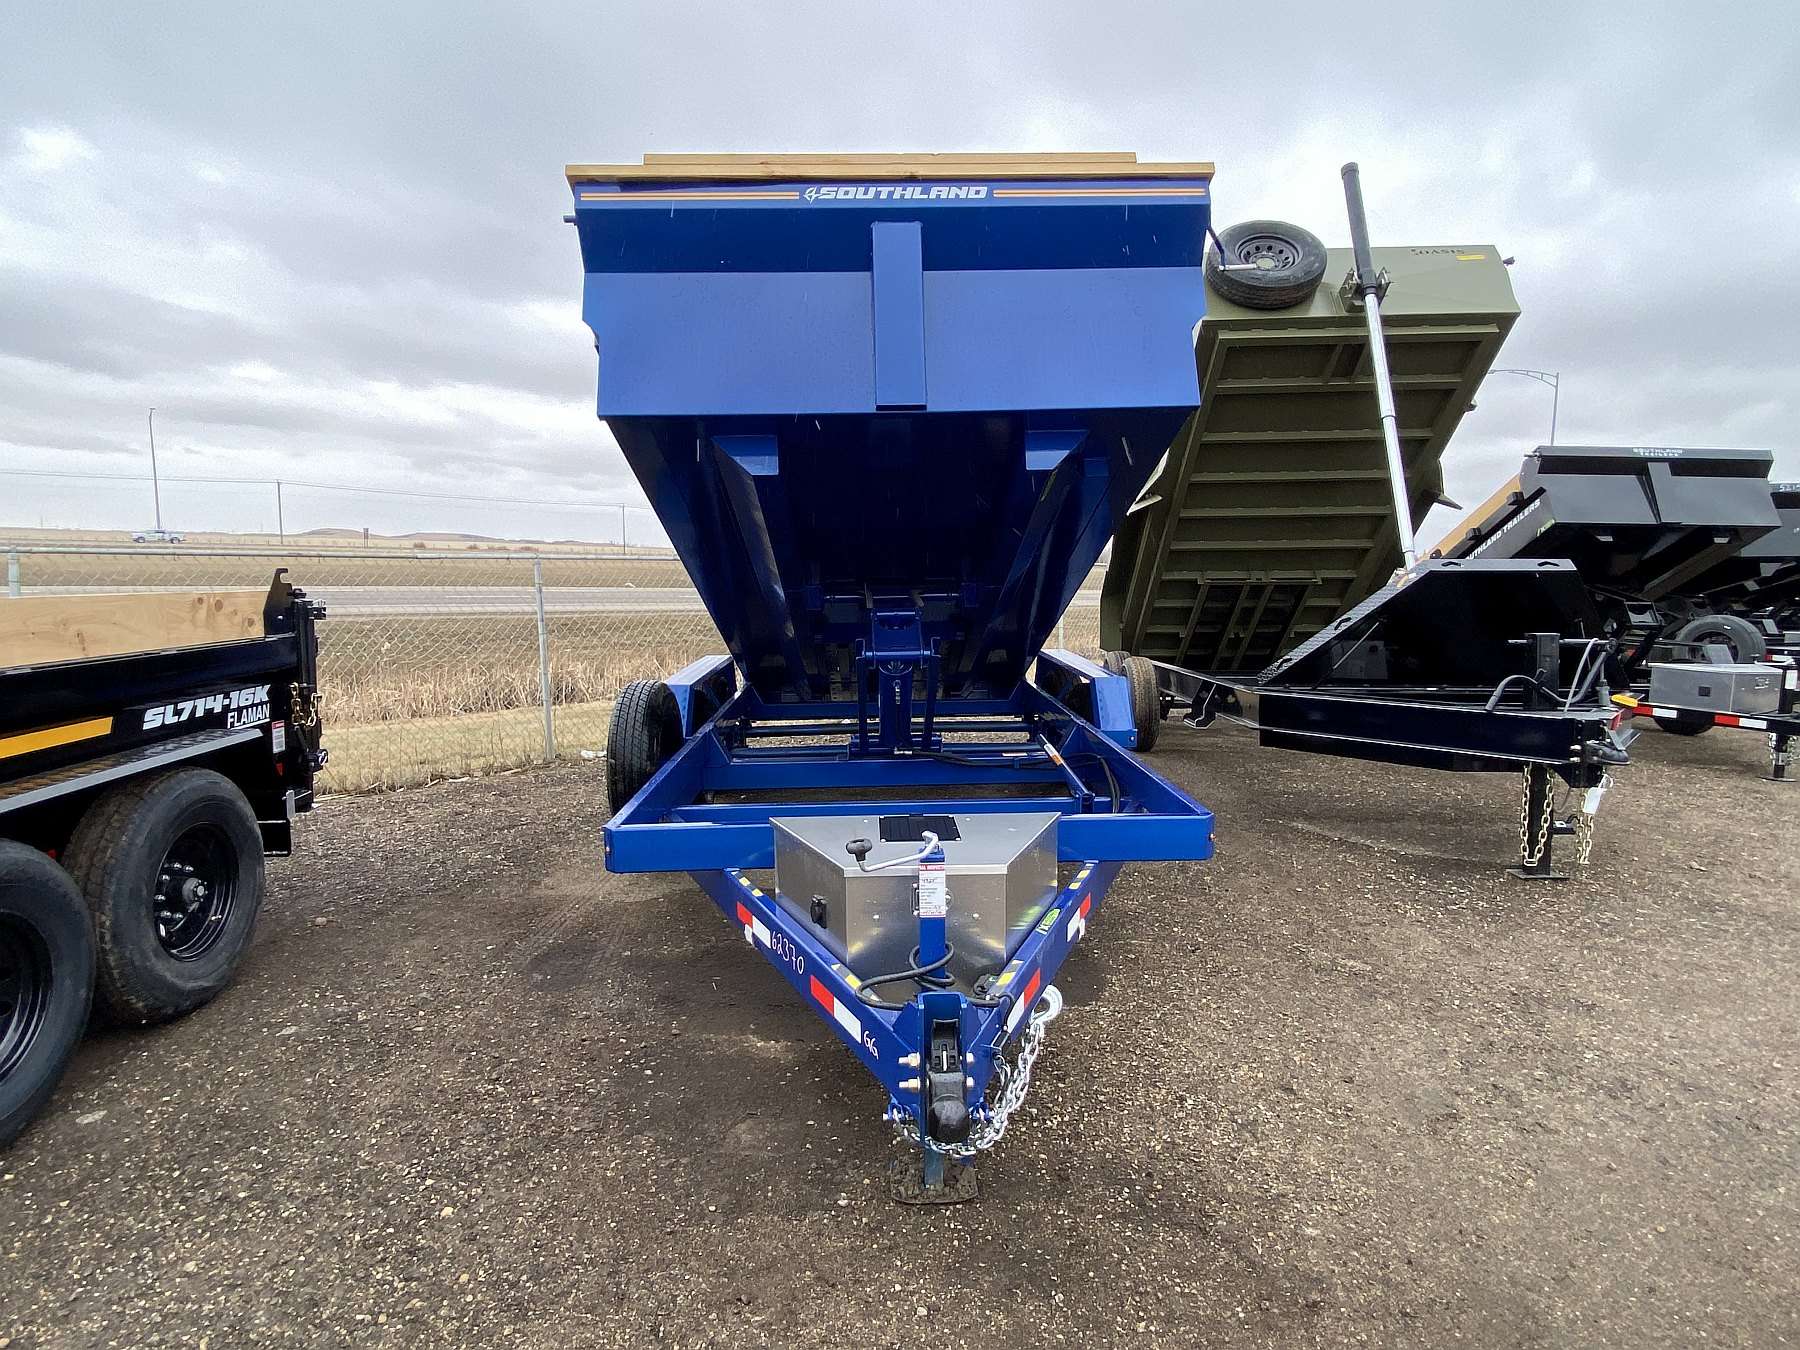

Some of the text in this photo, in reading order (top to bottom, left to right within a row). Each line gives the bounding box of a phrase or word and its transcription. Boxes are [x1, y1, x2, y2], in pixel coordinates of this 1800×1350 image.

[817, 186, 988, 200] SOUTHLAND
[1503, 498, 1541, 533] TRAILERS
[142, 684, 271, 730] SL714-16K
[227, 703, 270, 729] FLAMAN
[771, 931, 804, 974] 62370
